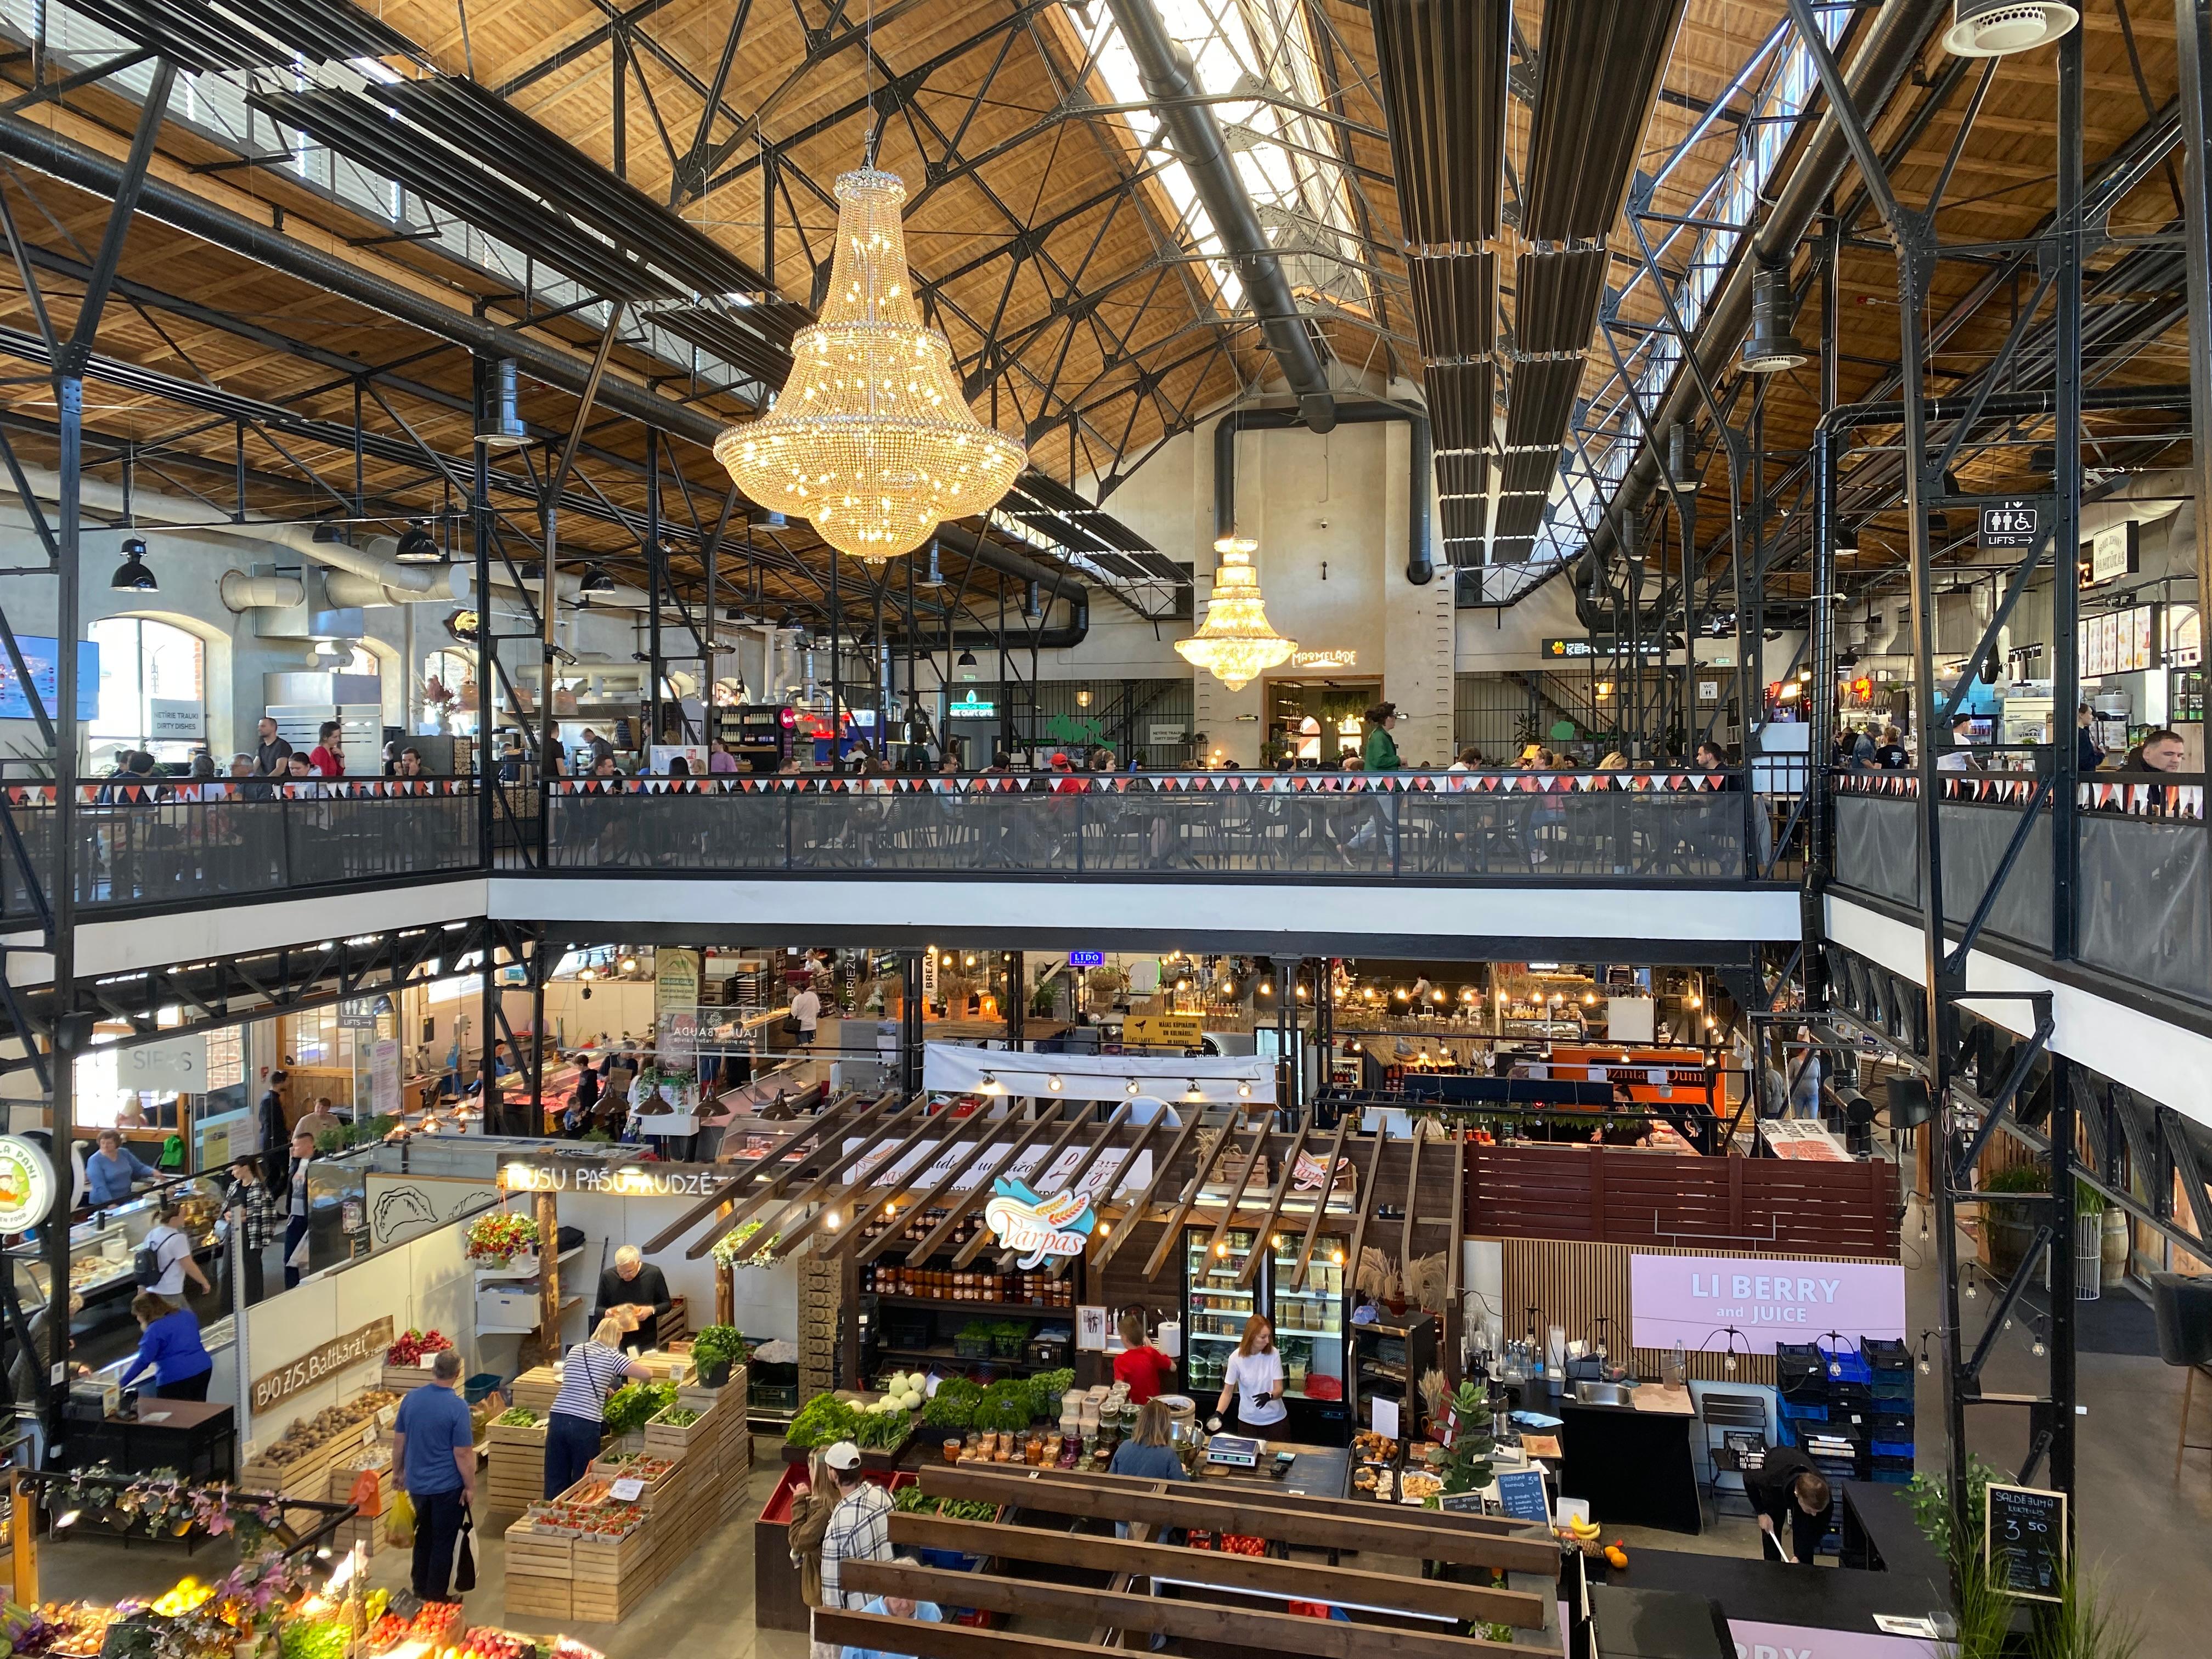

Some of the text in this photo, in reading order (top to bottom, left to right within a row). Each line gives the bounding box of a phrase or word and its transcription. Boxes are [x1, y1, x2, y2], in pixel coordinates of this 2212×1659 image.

[1988, 536, 2015, 545] LIFTS
[1291, 650, 1357, 666] MARMELADE
[154, 710, 176, 719] NETĪRIE
[15, 1150, 37, 1179] PANI
[854, 1160, 905, 1187] Vpas
[575, 1167, 629, 1193] PAŠU
[640, 1172, 737, 1195] AUDZĒ
[10, 1212, 26, 1223] FOOD
[1001, 1209, 1083, 1264] Varpas
[1691, 1273, 1841, 1304] LI BERRY
[1716, 1305, 1807, 1324] and JUICE
[257, 1376, 281, 1407] BIO
[2005, 1519, 2047, 1541] 3 50
